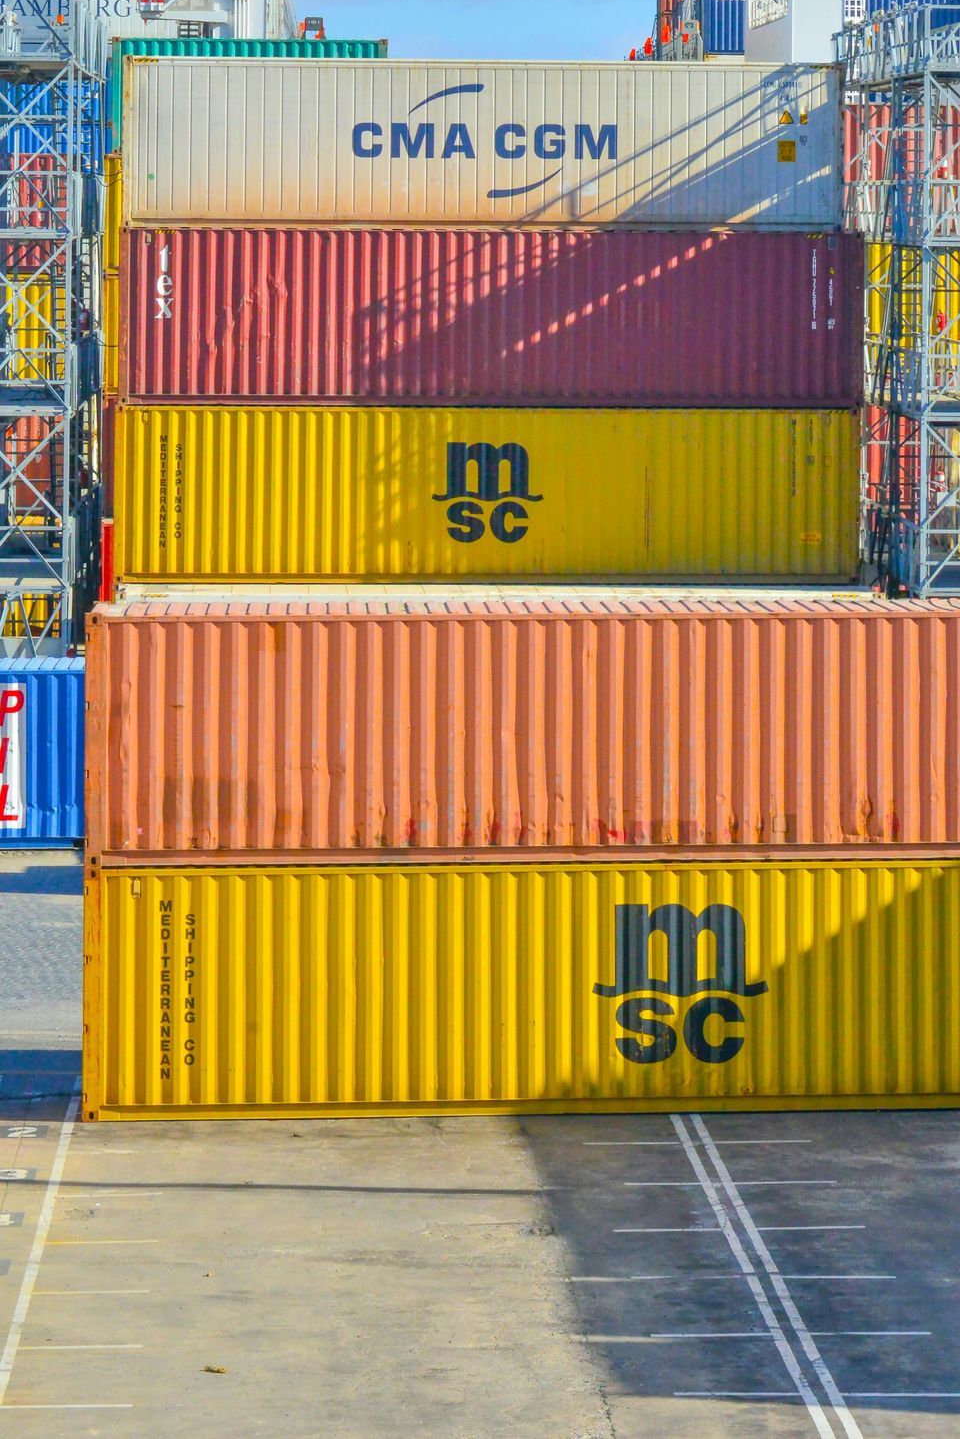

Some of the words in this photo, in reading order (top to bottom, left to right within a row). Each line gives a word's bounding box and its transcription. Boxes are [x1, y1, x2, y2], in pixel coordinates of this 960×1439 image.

[352, 122, 476, 159] CMA
[494, 123, 618, 160] CGM
[154, 244, 174, 319] tex
[159, 435, 167, 548] MEDITERRANEAN
[174, 522, 182, 539] CO
[160, 900, 173, 1080] MEDITERRANEAN
[184, 913, 196, 1024] SHIPPING
[184, 1039, 196, 1066] CO
[8, 1126, 38, 1138] 2
